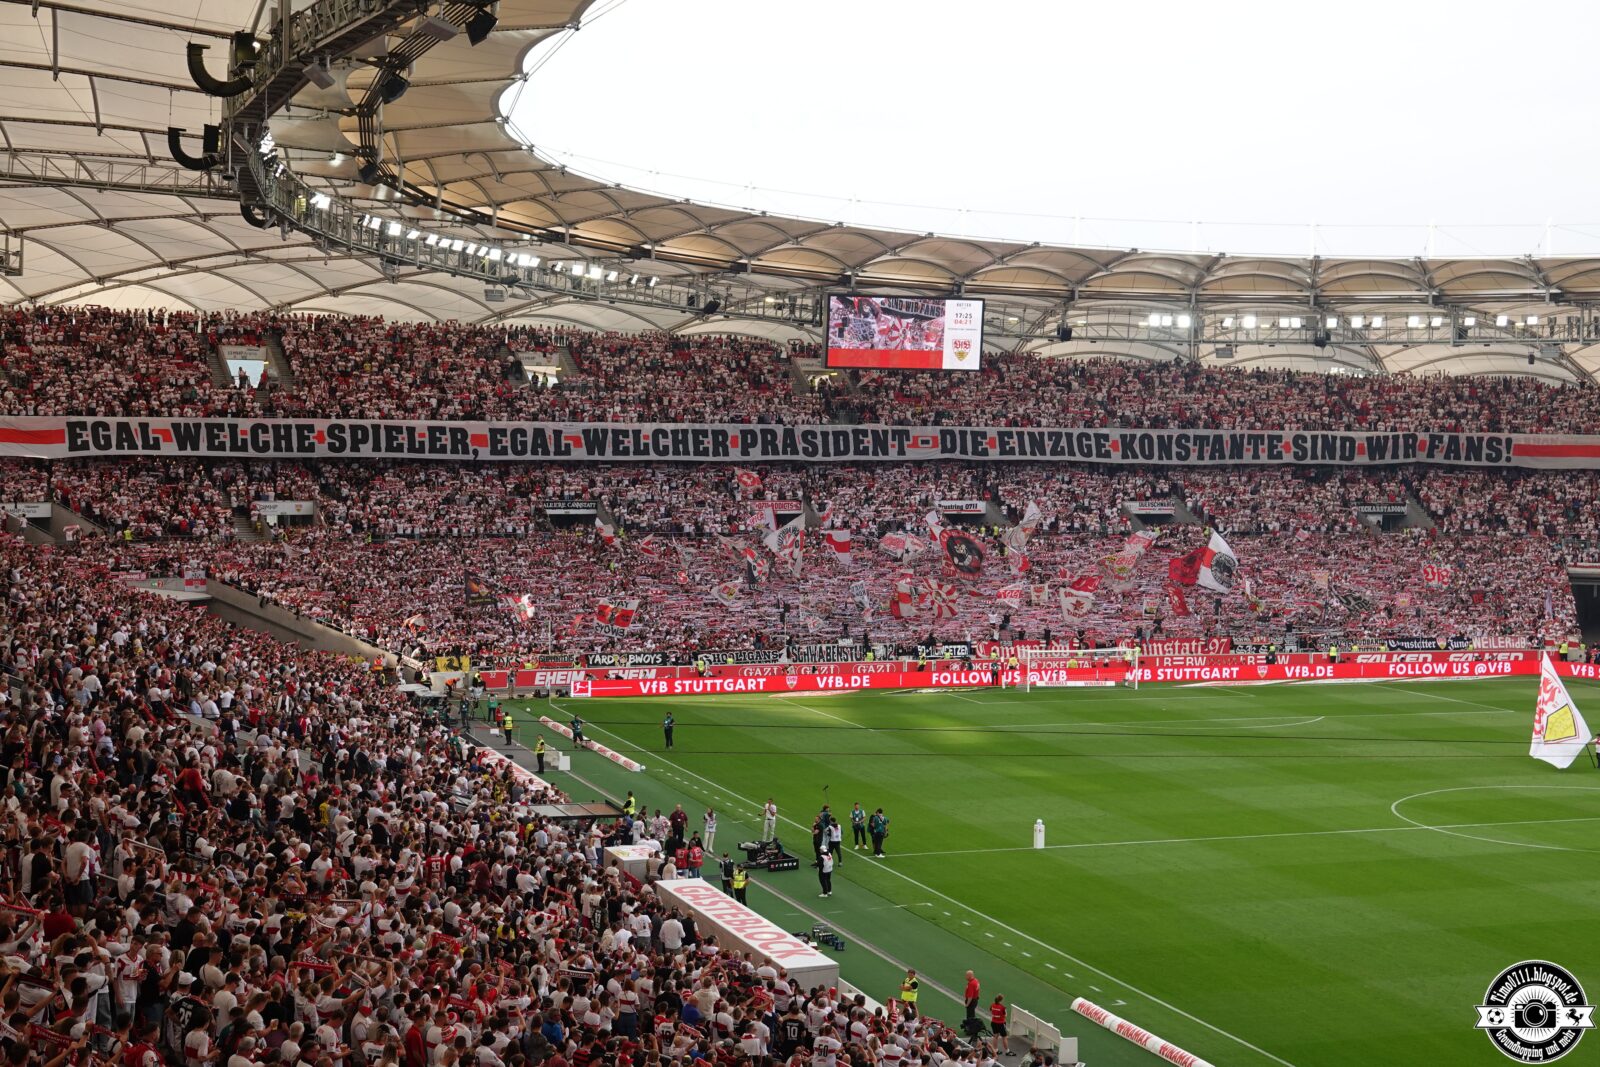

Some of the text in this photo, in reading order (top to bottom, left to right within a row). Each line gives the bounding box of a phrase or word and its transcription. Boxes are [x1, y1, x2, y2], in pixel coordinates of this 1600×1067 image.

[66, 420, 161, 452] EGAL
[171, 422, 316, 453] WELCHE
[327, 423, 480, 461] SPIELER,
[488, 427, 572, 456] EGAL
[582, 428, 729, 458] WELCHER
[939, 429, 990, 457] DIE
[996, 429, 1112, 459] EINZIGE
[1119, 432, 1283, 462] KONSTANTE
[1292, 433, 1356, 462] SIND
[1366, 432, 1418, 461] WIR
[1426, 432, 1513, 463] FANS!
[588, 653, 663, 666] YARD BWOYS
[1356, 654, 1432, 663] FALKEN
[744, 664, 891, 677] GAZI GZI GAZI
[1125, 667, 1240, 681] VfB STUTTGART
[1284, 665, 1334, 678] VfB.DE
[1389, 662, 1512, 675] FOLLOW US @VfB
[1570, 664, 1595, 677] VfB
[535, 671, 585, 686] EHEIM
[816, 675, 871, 689] VfB.DE
[931, 669, 1067, 685] FOLLOW US @VfB
[639, 678, 767, 694] VfB STUTTGART
[1076, 1000, 1110, 1026] WINAMAX
[786, 1026, 799, 1038] 10
[1116, 1021, 1153, 1047] WINAMAX
[818, 1044, 829, 1058] 50
